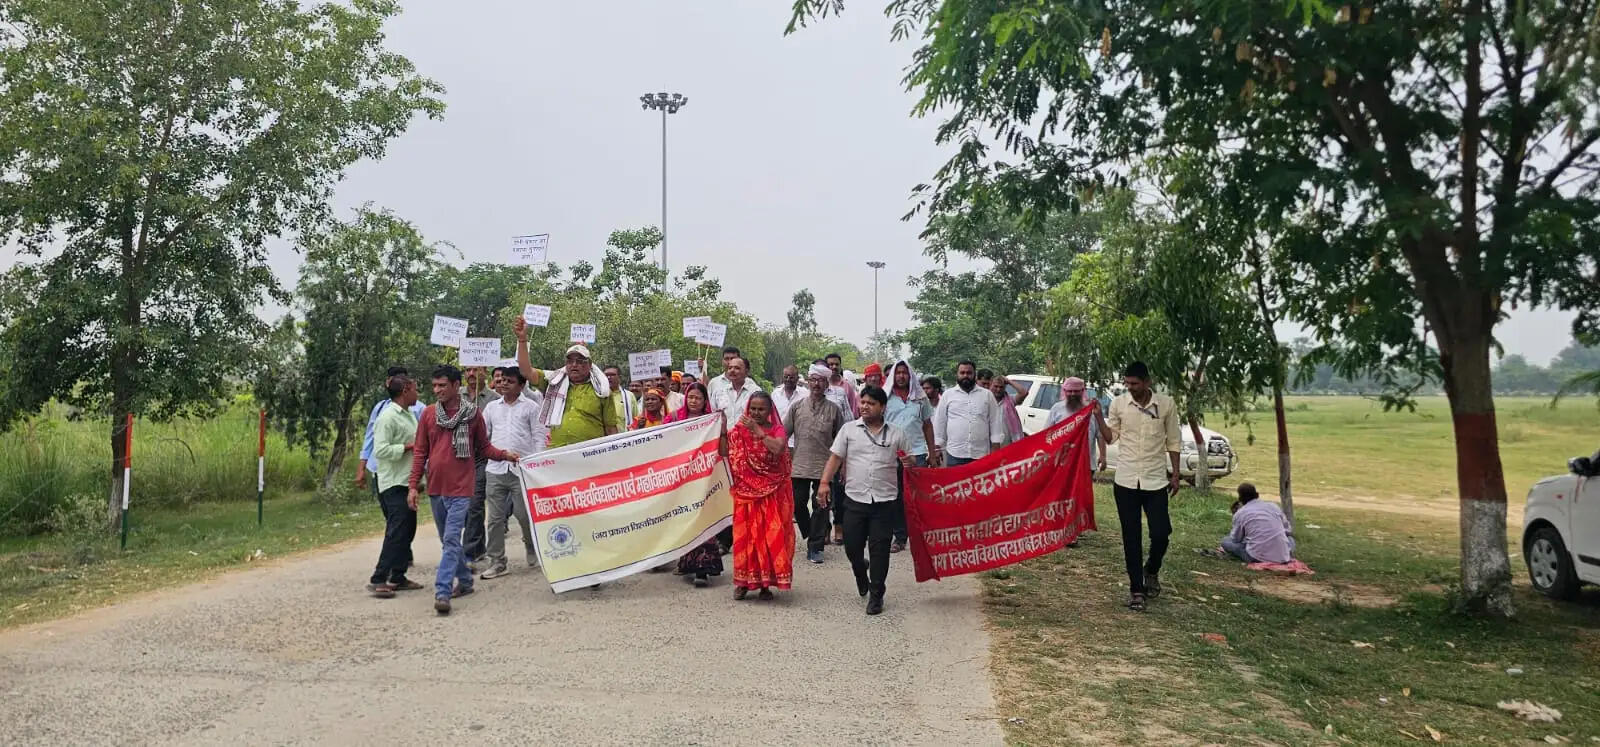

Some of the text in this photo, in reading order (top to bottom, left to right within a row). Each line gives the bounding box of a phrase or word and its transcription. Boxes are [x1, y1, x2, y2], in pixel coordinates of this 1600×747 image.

[532, 493, 556, 517] बिहार
[556, 492, 573, 512] राज्य
[571, 481, 623, 510] विश्वविद्यालय
[623, 471, 636, 498] एवं
[637, 466, 681, 494] महाविद्यालय
[680, 450, 707, 480] कर्मचारी
